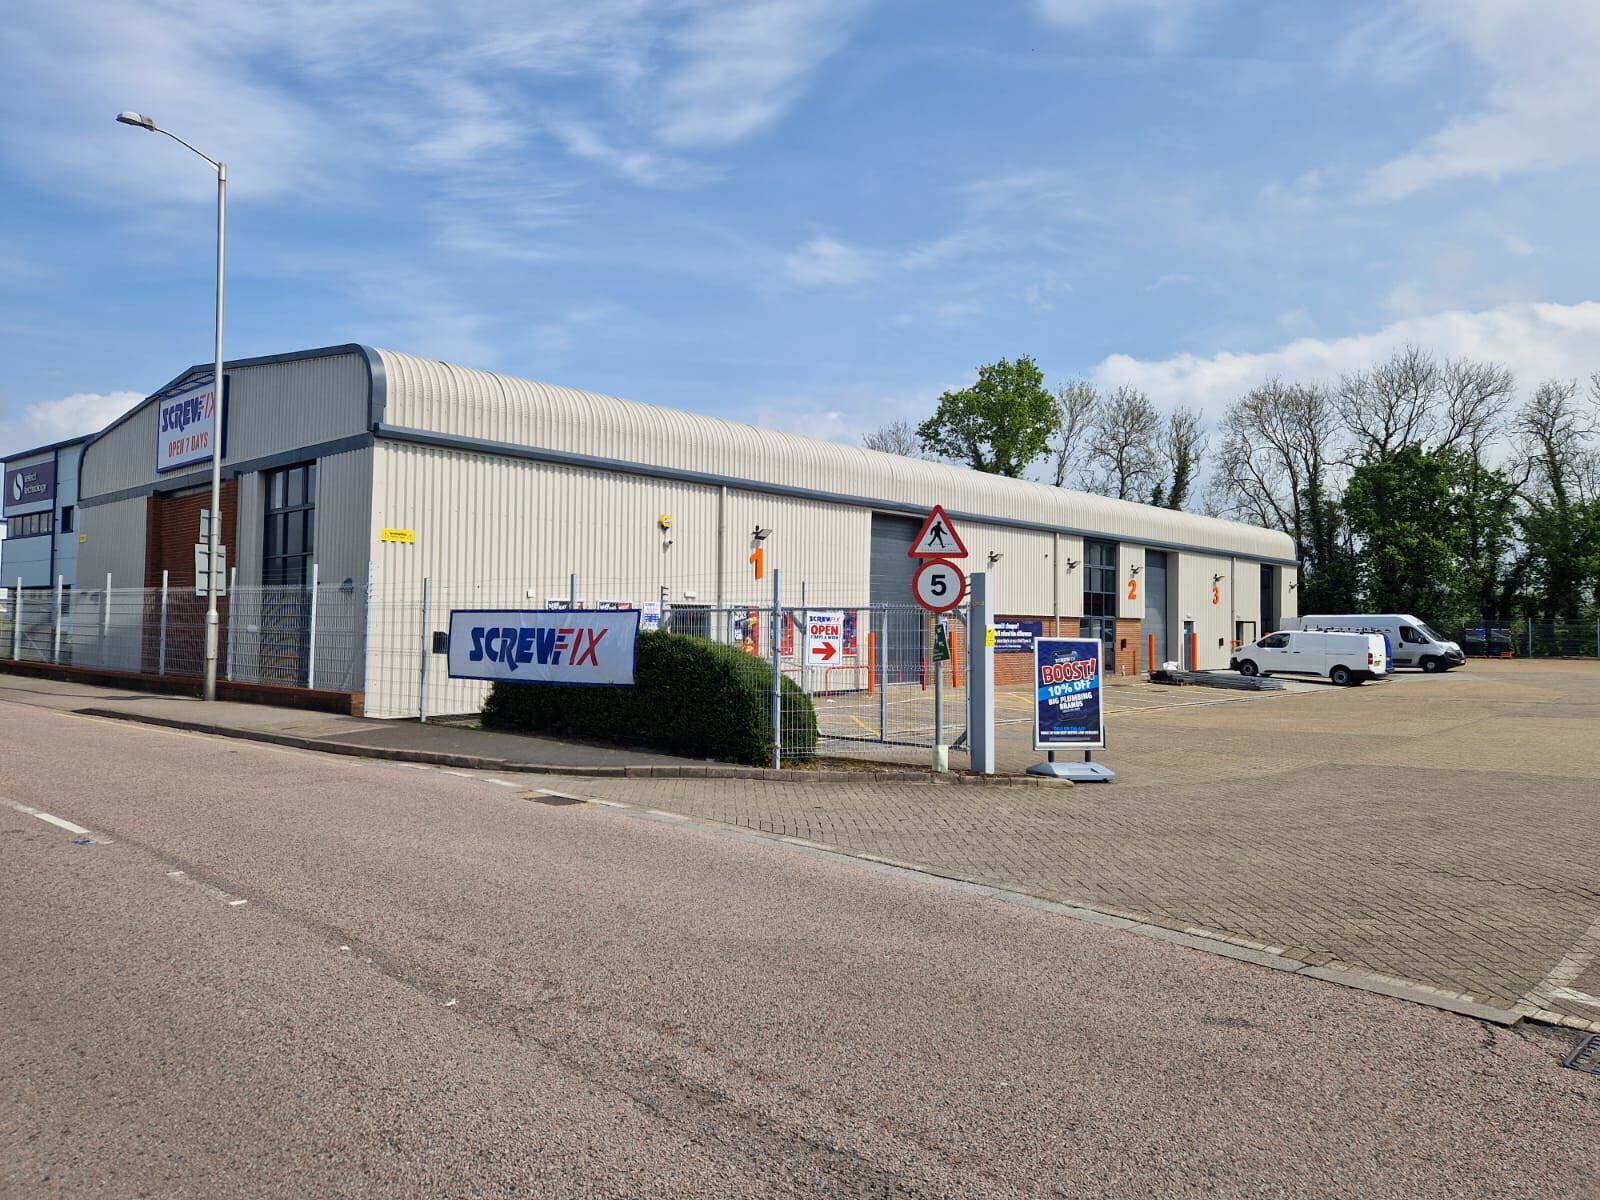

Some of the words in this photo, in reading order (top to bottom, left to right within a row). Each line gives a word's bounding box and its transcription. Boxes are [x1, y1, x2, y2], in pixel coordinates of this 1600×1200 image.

[168, 440, 184, 458] OPEN
[185, 437, 190, 453] 7
[191, 432, 208, 452] DAYS
[749, 548, 763, 580] 1
[931, 574, 947, 596] 5
[1128, 580, 1137, 600] 2
[1212, 586, 1219, 605] 3
[811, 624, 839, 636] OPEN
[469, 627, 609, 672] SCREWFIX
[1042, 657, 1097, 685] BOOST!
[1048, 683, 1073, 697] 10%
[1048, 697, 1060, 706] BIG
[1060, 691, 1093, 704] PLUMBING
